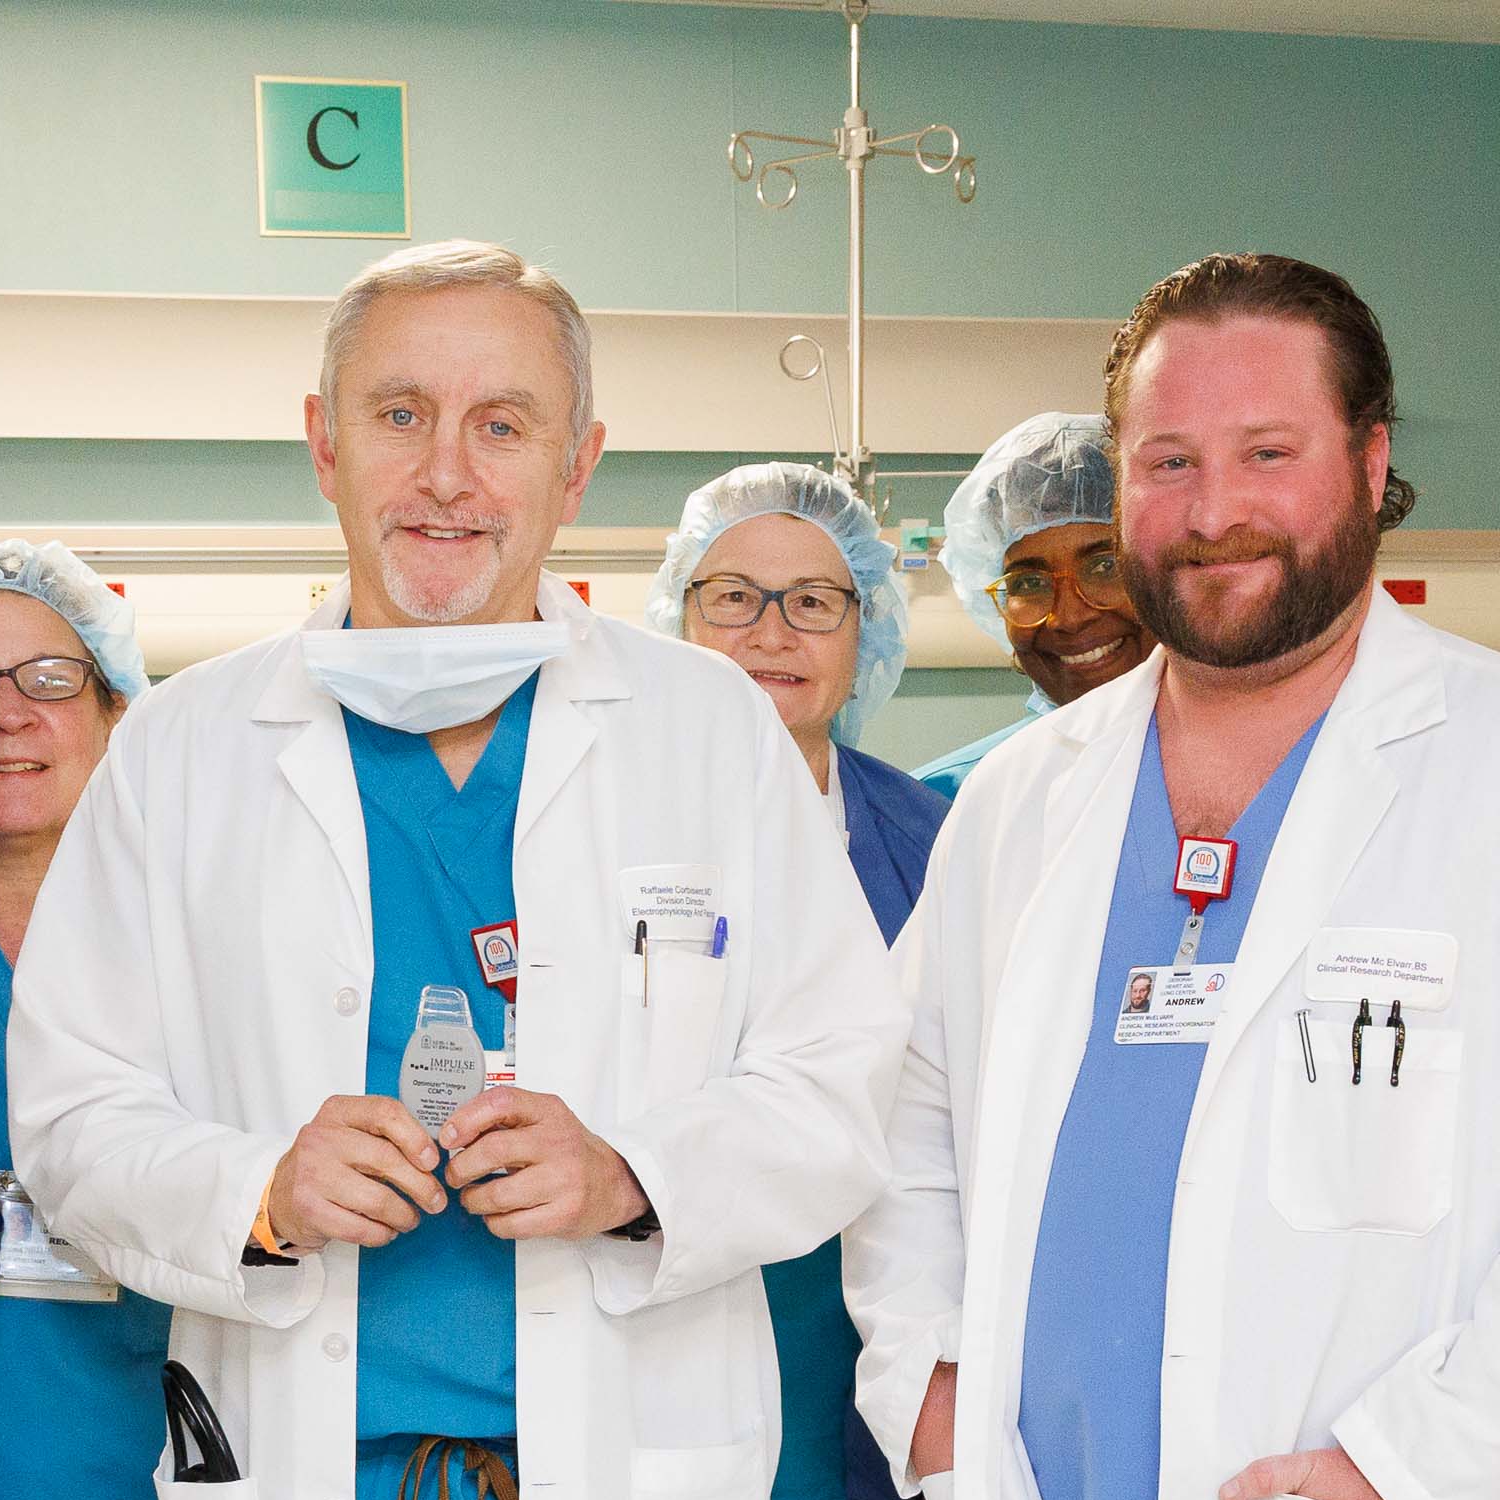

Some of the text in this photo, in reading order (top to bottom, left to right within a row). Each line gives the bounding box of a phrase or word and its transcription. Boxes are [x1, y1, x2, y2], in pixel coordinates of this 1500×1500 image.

[307, 106, 361, 171] C
[1195, 853, 1212, 866] 100
[640, 886, 673, 894] Raffaele
[656, 896, 685, 904] Division
[488, 941, 504, 955] 100
[1335, 954, 1368, 965] Andrew
[1371, 957, 1385, 966] Mc
[1316, 963, 1444, 985] Clinical Research Department
[1165, 998, 1206, 1006] ANDREW
[430, 1058, 475, 1070] IMPULSE
